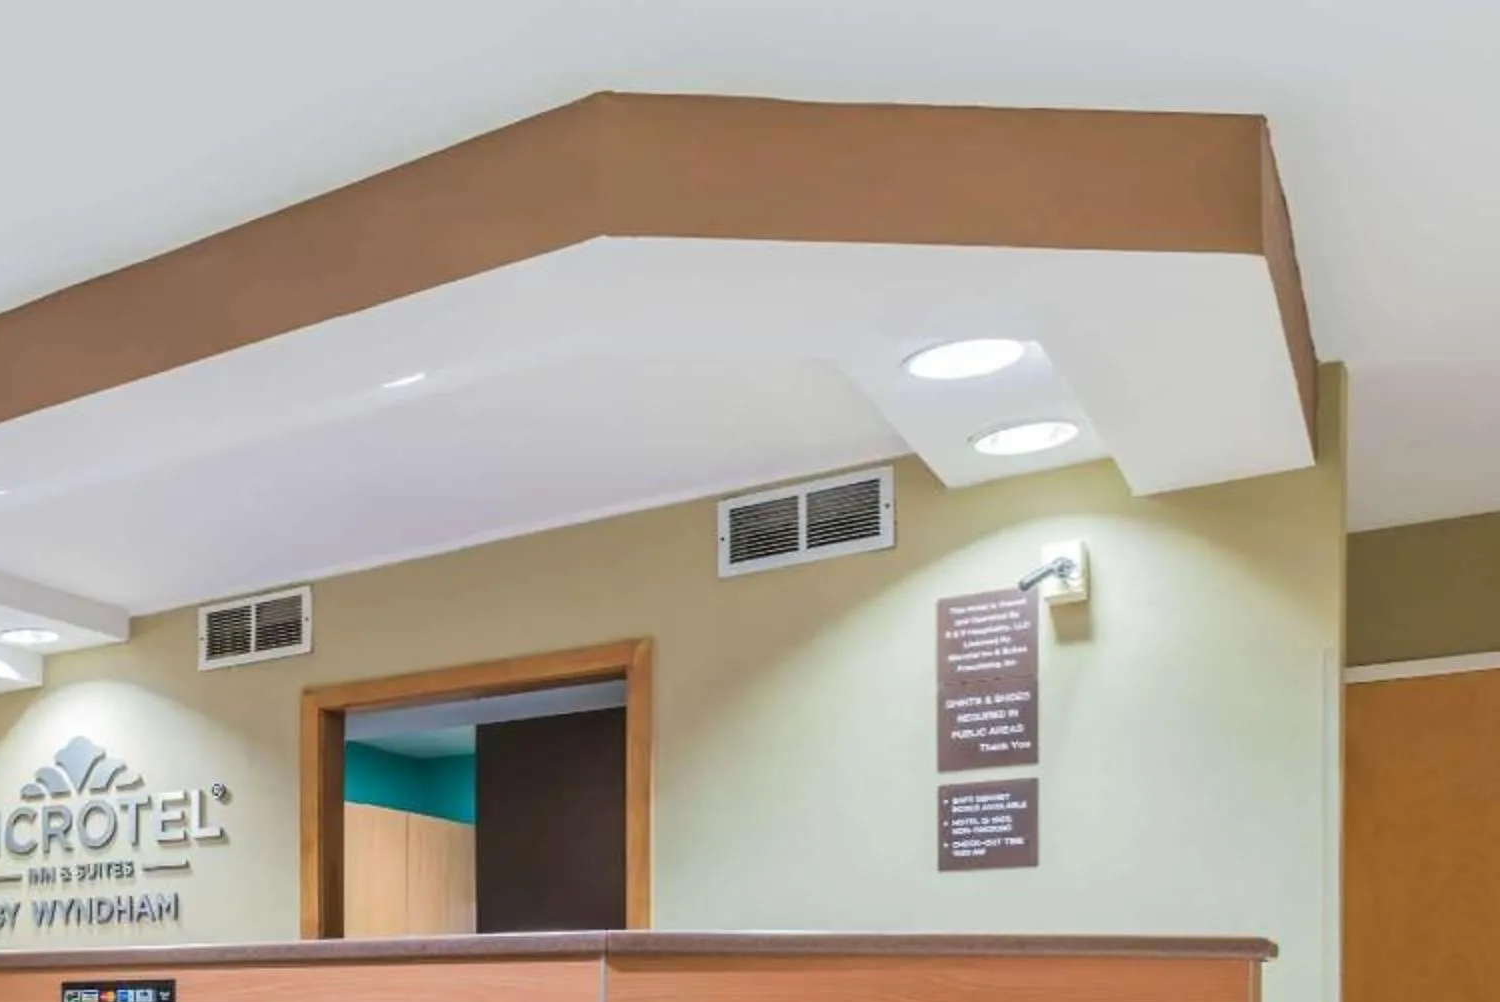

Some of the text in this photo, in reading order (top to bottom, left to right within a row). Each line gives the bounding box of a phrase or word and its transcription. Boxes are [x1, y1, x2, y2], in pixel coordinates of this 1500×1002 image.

[950, 723, 1024, 739] PUBLIC AREAS
[1011, 739, 1031, 749] You
[28, 860, 135, 886] INN & SUITES
[32, 892, 180, 929] WYNDHAM
